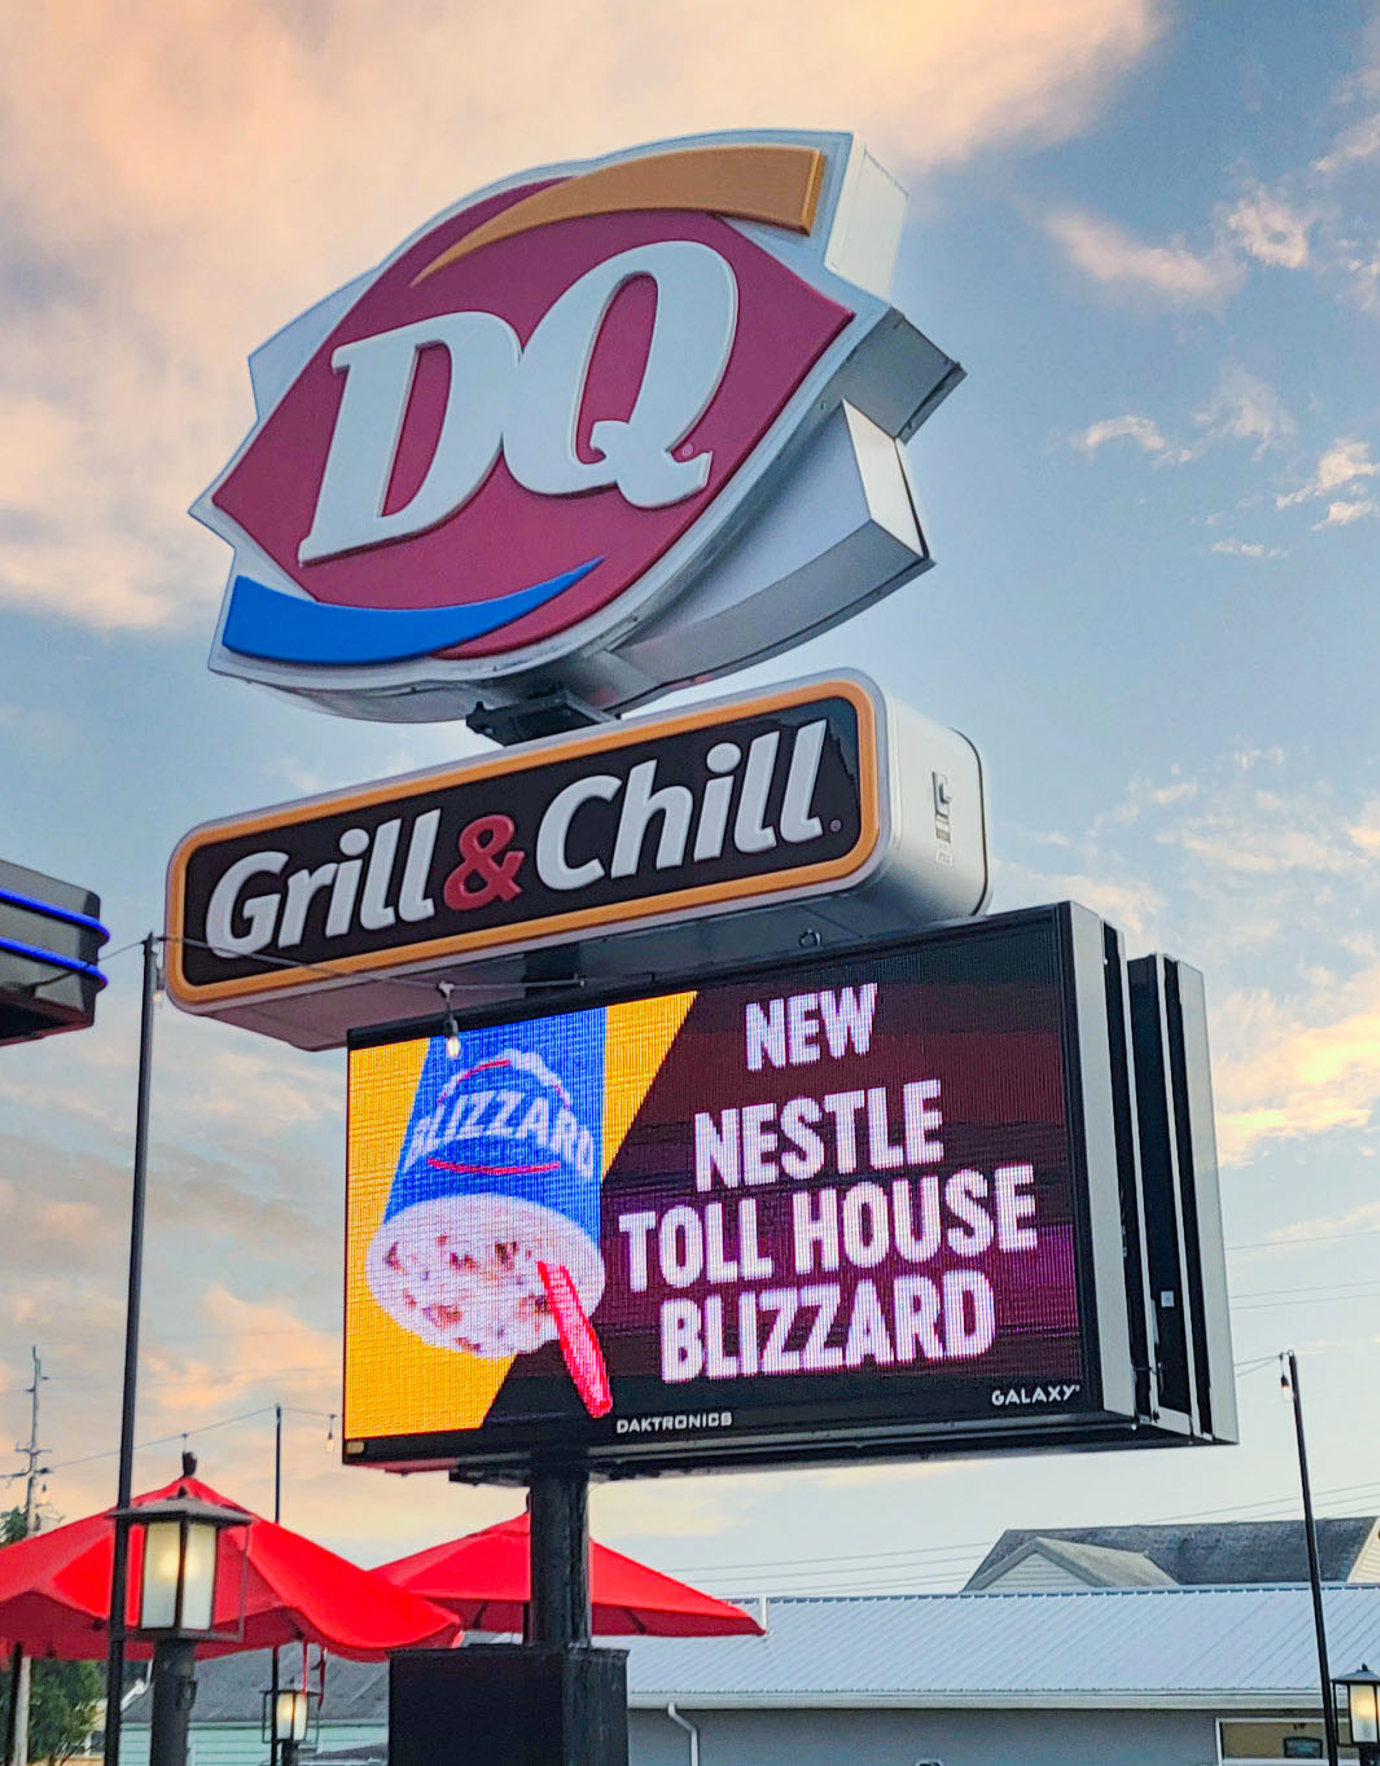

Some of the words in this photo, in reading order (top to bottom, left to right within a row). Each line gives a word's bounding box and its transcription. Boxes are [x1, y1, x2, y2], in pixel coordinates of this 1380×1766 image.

[297, 240, 740, 566] DQ
[206, 808, 442, 959] Grill
[536, 719, 827, 891] Chill
[745, 982, 878, 1072] NEW
[694, 1079, 944, 1192] NESTLE
[618, 1197, 775, 1293] TOLL
[792, 1164, 1039, 1276] HOUSE
[660, 1269, 997, 1384] BLIZZARD
[616, 1411, 733, 1434] DAKTRONICS
[991, 1384, 1080, 1406] GALAXY
